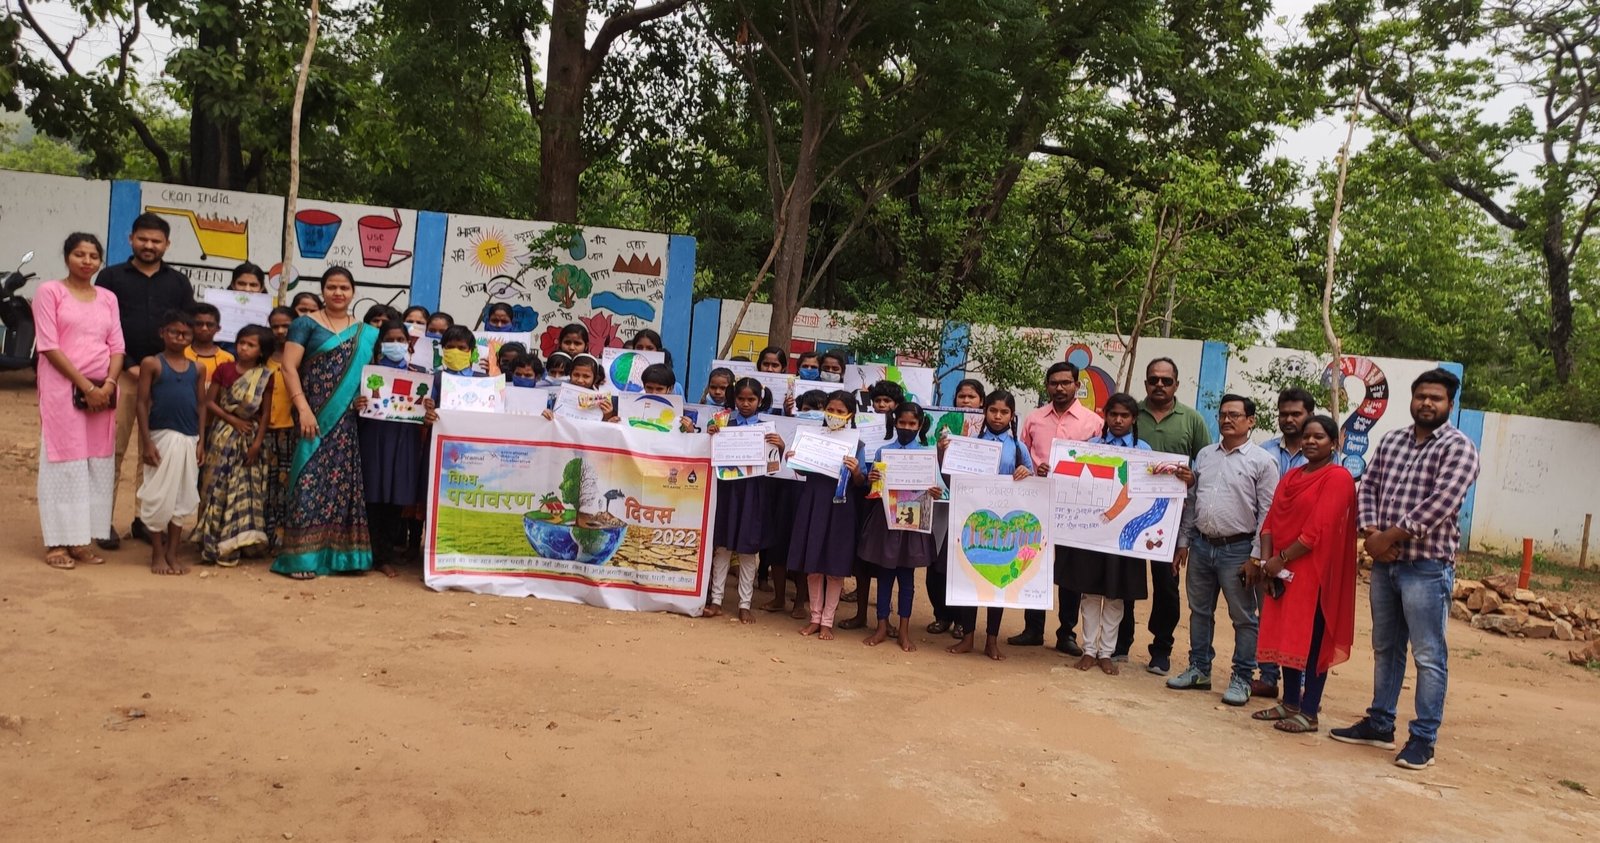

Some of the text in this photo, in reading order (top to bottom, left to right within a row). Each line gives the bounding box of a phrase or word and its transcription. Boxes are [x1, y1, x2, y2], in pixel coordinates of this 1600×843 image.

[197, 191, 229, 204] India
[333, 246, 354, 256] DRY
[447, 469, 479, 487] विश्व
[447, 484, 536, 510] पर्यावरण
[625, 496, 676, 525] दिवस
[652, 529, 698, 548] 2022
